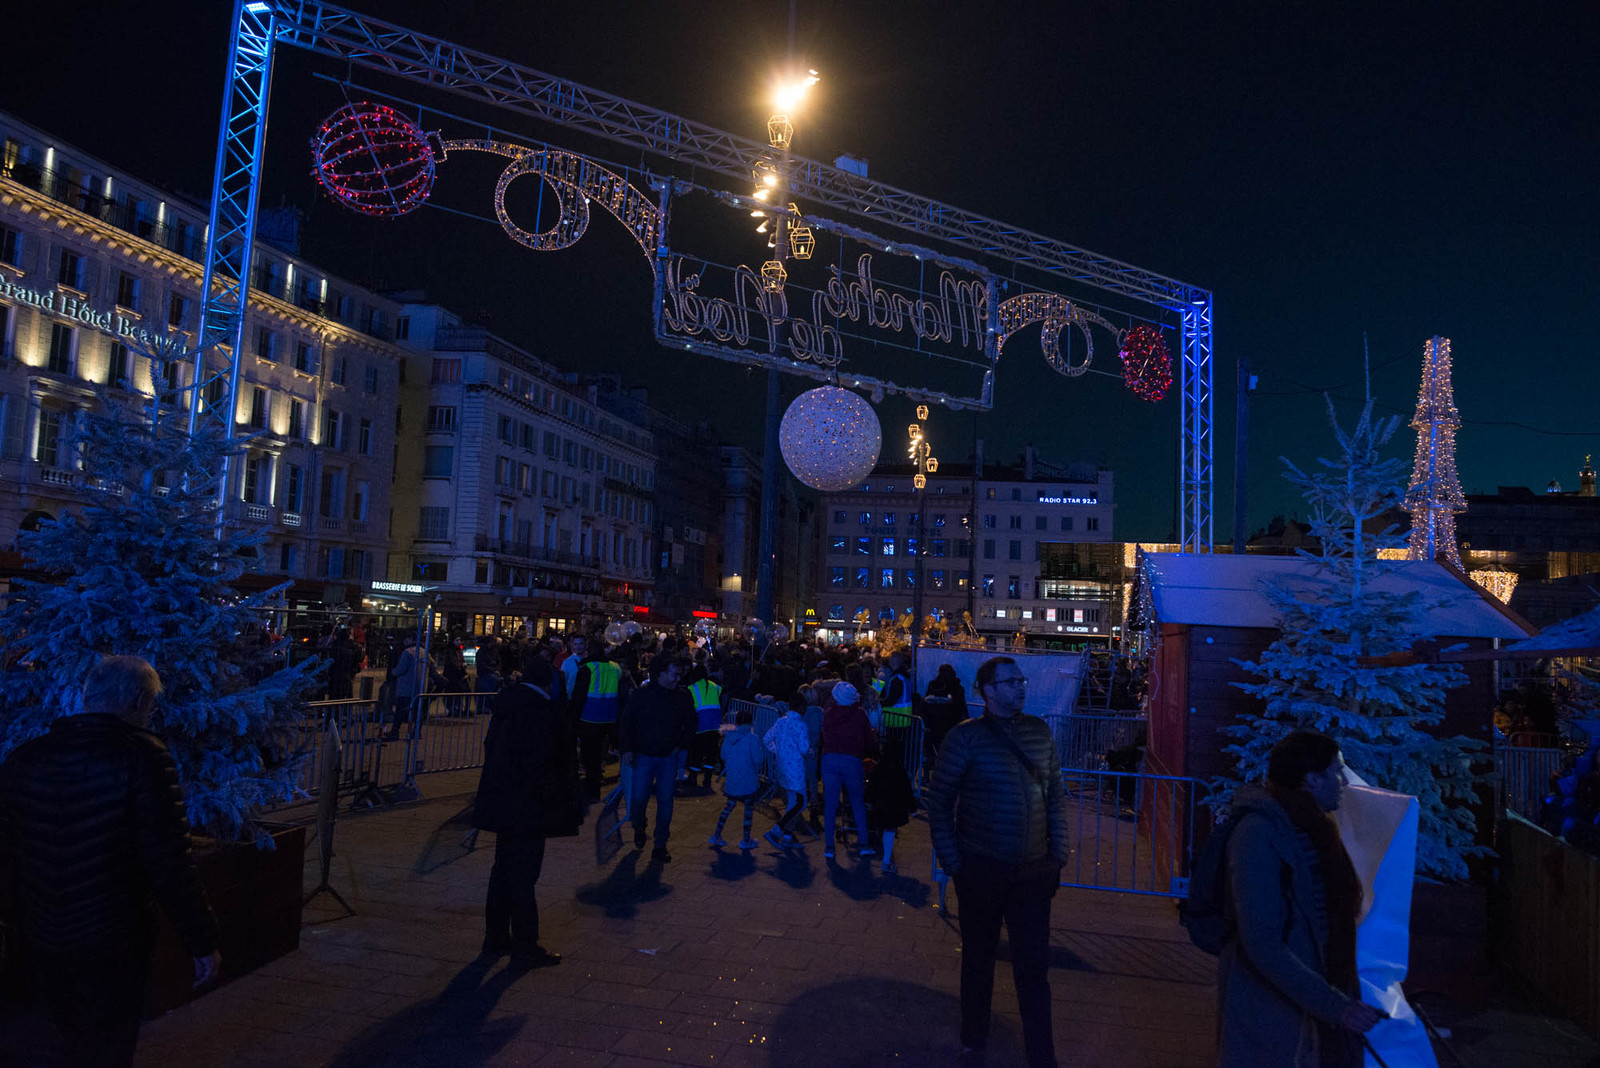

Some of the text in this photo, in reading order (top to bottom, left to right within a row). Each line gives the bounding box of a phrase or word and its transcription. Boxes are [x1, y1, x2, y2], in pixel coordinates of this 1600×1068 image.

[60, 297, 113, 333] Hôtel
[117, 315, 189, 355] Beauv
[371, 581, 422, 593] BRASSERIE LE SOLEIL
[1066, 625, 1089, 633] GLACIER
